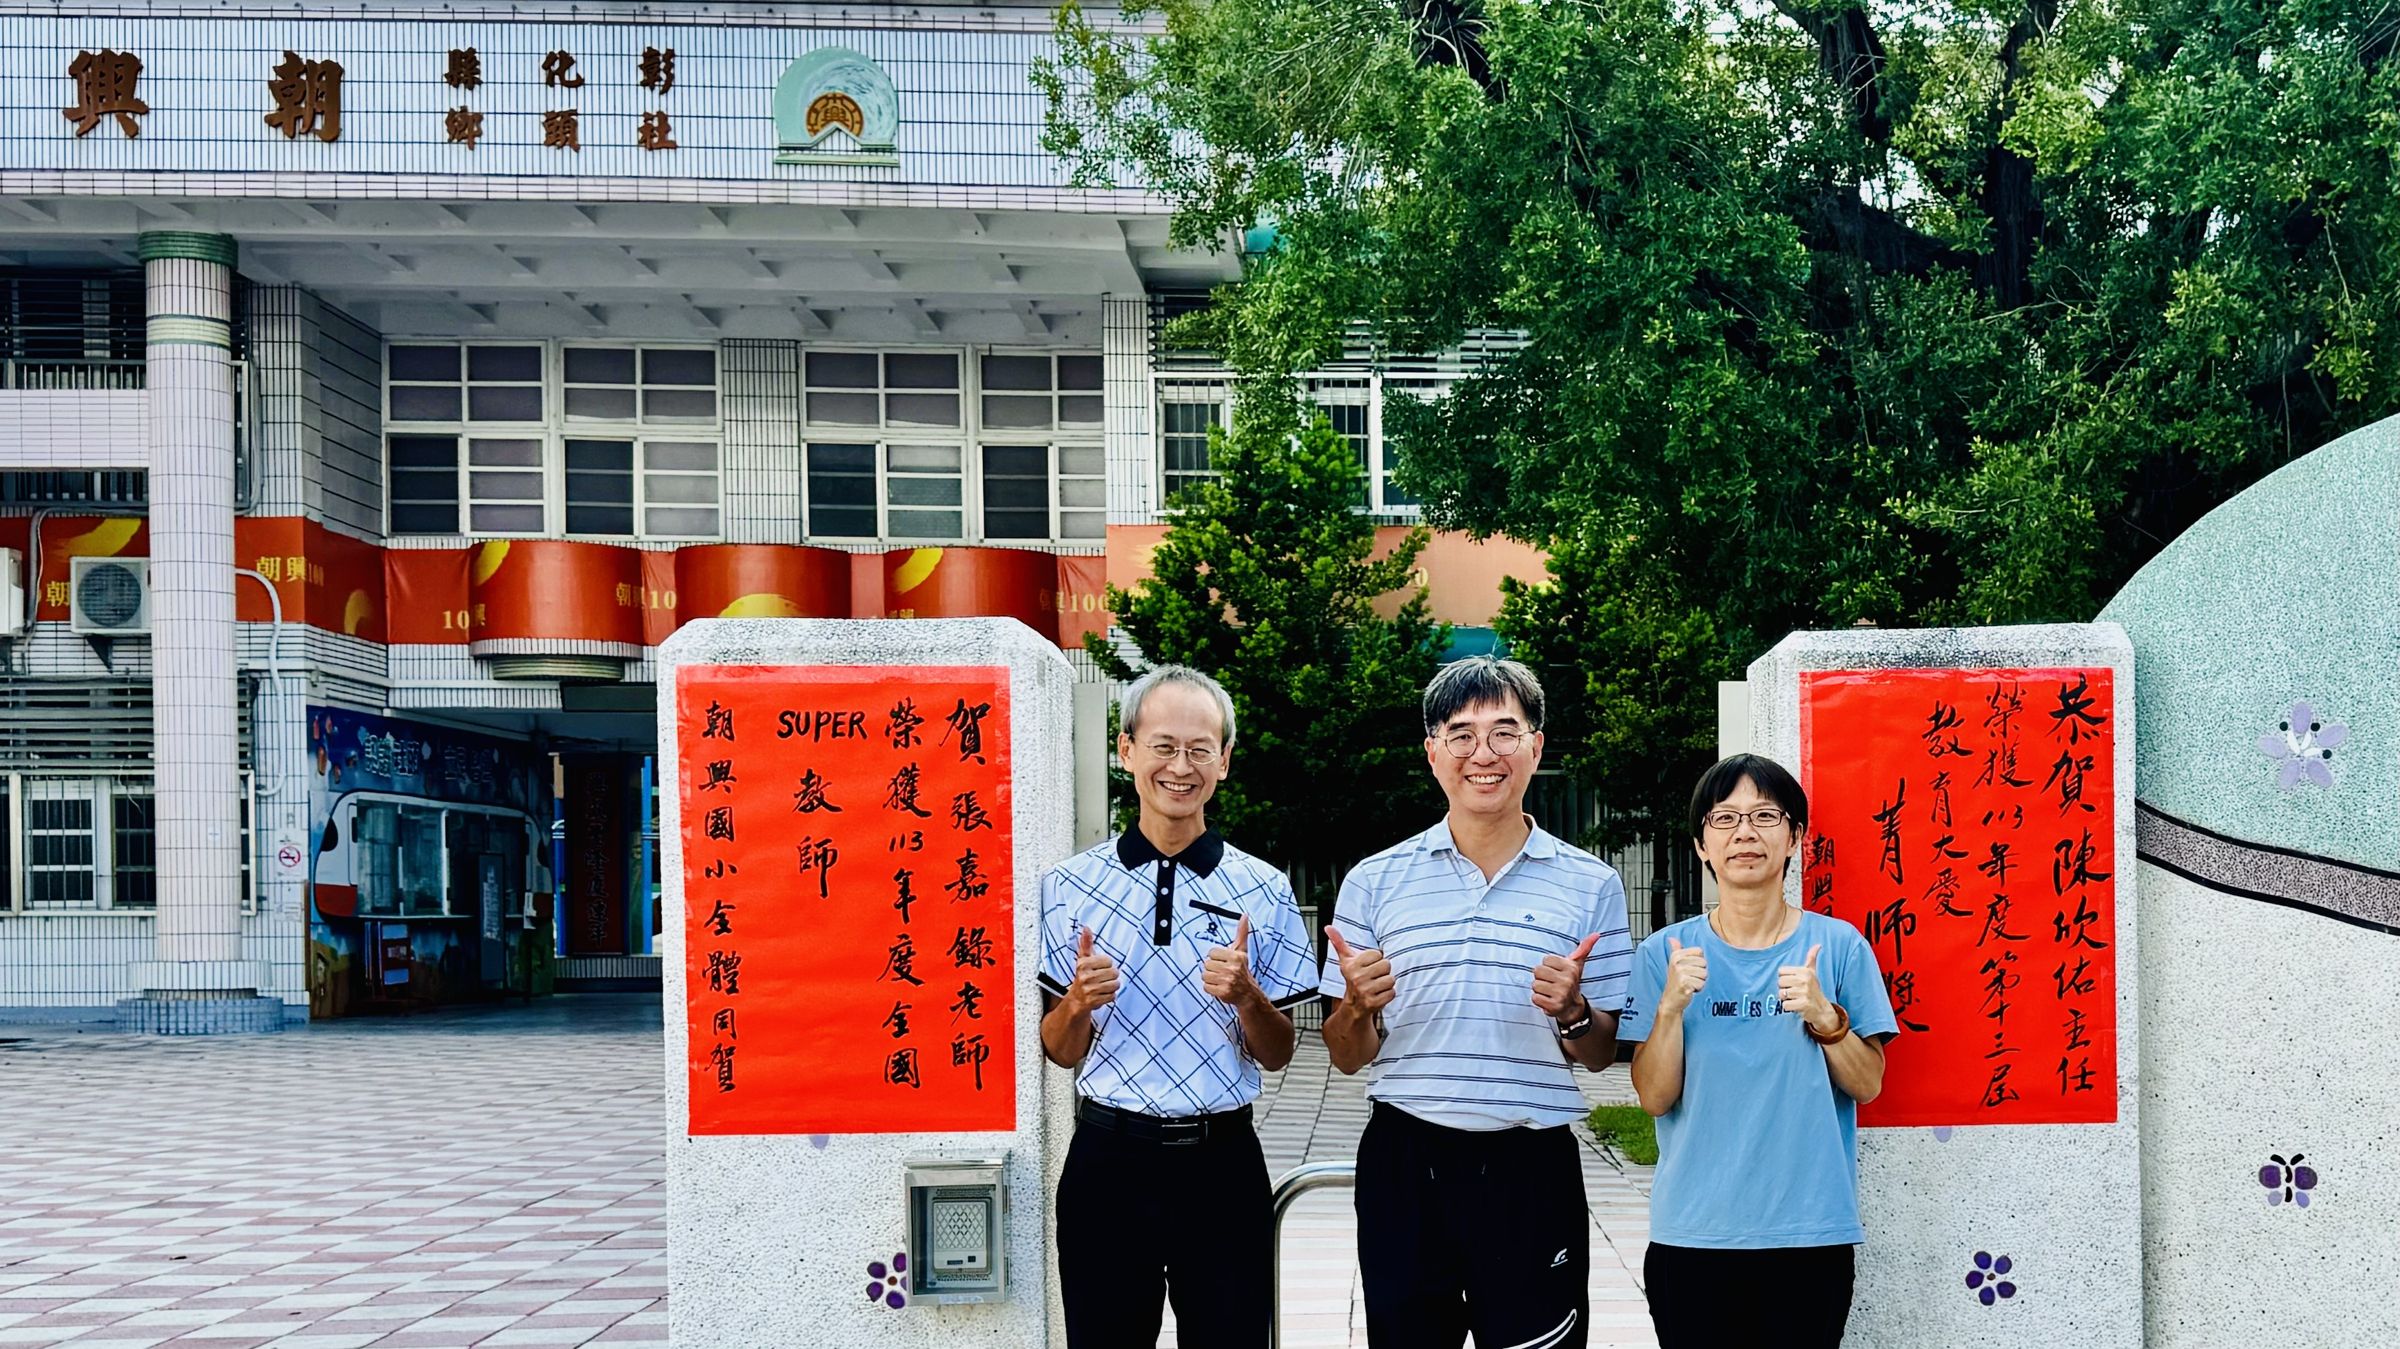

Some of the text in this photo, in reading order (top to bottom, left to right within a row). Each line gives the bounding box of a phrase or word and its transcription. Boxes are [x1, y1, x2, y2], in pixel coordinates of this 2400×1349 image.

[698, 700, 742, 1093] 朝興國小全體同賀
[777, 709, 868, 899] SUPER 教師
